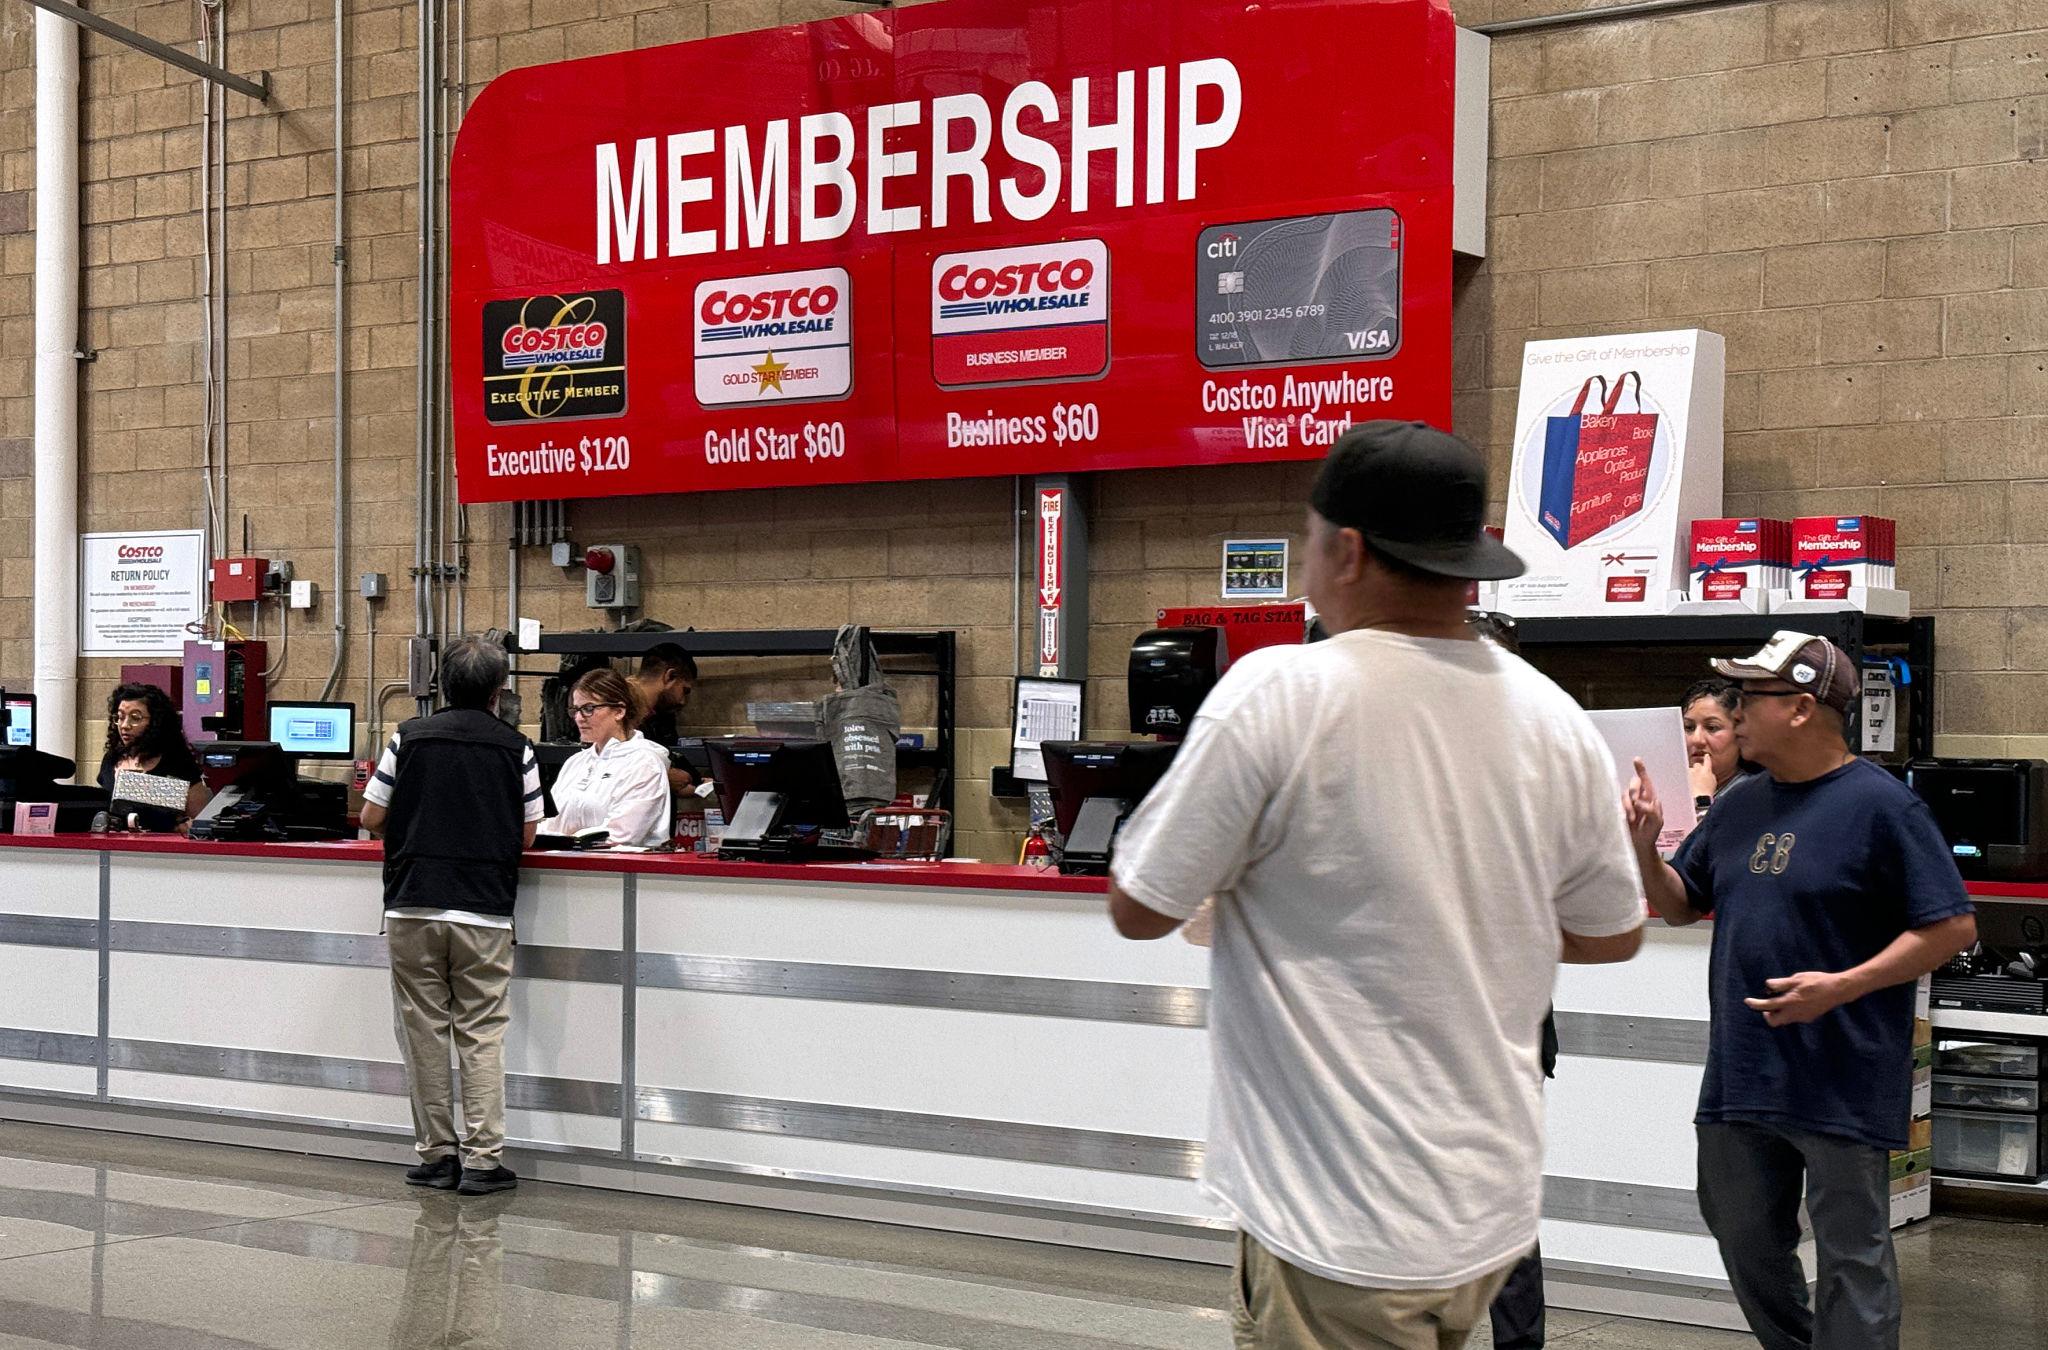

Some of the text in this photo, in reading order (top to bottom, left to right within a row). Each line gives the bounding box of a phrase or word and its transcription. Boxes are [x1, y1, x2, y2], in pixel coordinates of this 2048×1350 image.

[596, 57, 1242, 265] MEMBERSHIP
[1207, 238, 1238, 258] citi
[939, 258, 1094, 302] COSTCO
[701, 285, 839, 326] COSTCO
[987, 293, 1090, 315] WHOLESALE
[1209, 304, 1325, 324] 4100 3901 2345 6789
[742, 318, 835, 339] WHOLESALE
[503, 324, 607, 354] COSTCO
[1344, 330, 1391, 350] VISA
[534, 348, 603, 364] WHOLESALE
[966, 347, 1067, 367] BUSINESS MEMBER
[1526, 344, 1690, 366] Give the Gift of Membership
[723, 367, 819, 386] GOLD STAR MEMBER
[491, 385, 620, 404] EXECUTIVE MEMBER
[1202, 371, 1394, 413] Costco Anywhere
[947, 402, 1099, 448] Business $60
[1581, 414, 1618, 430] Bakery
[704, 421, 845, 464] Gold Star $60
[486, 436, 630, 477] Executive $120
[1576, 446, 1629, 466] Appliances
[1604, 456, 1637, 474] Optical
[1044, 501, 1059, 512] FIRE
[1570, 492, 1613, 517] Furniture
[118, 545, 164, 558] COSTCO
[1696, 541, 1757, 553] Membership
[1798, 539, 1861, 551] Membership
[111, 569, 170, 581] RETURN POLICY
[1183, 610, 1305, 626] BAG & TAG STAT
[844, 742, 863, 751] with
